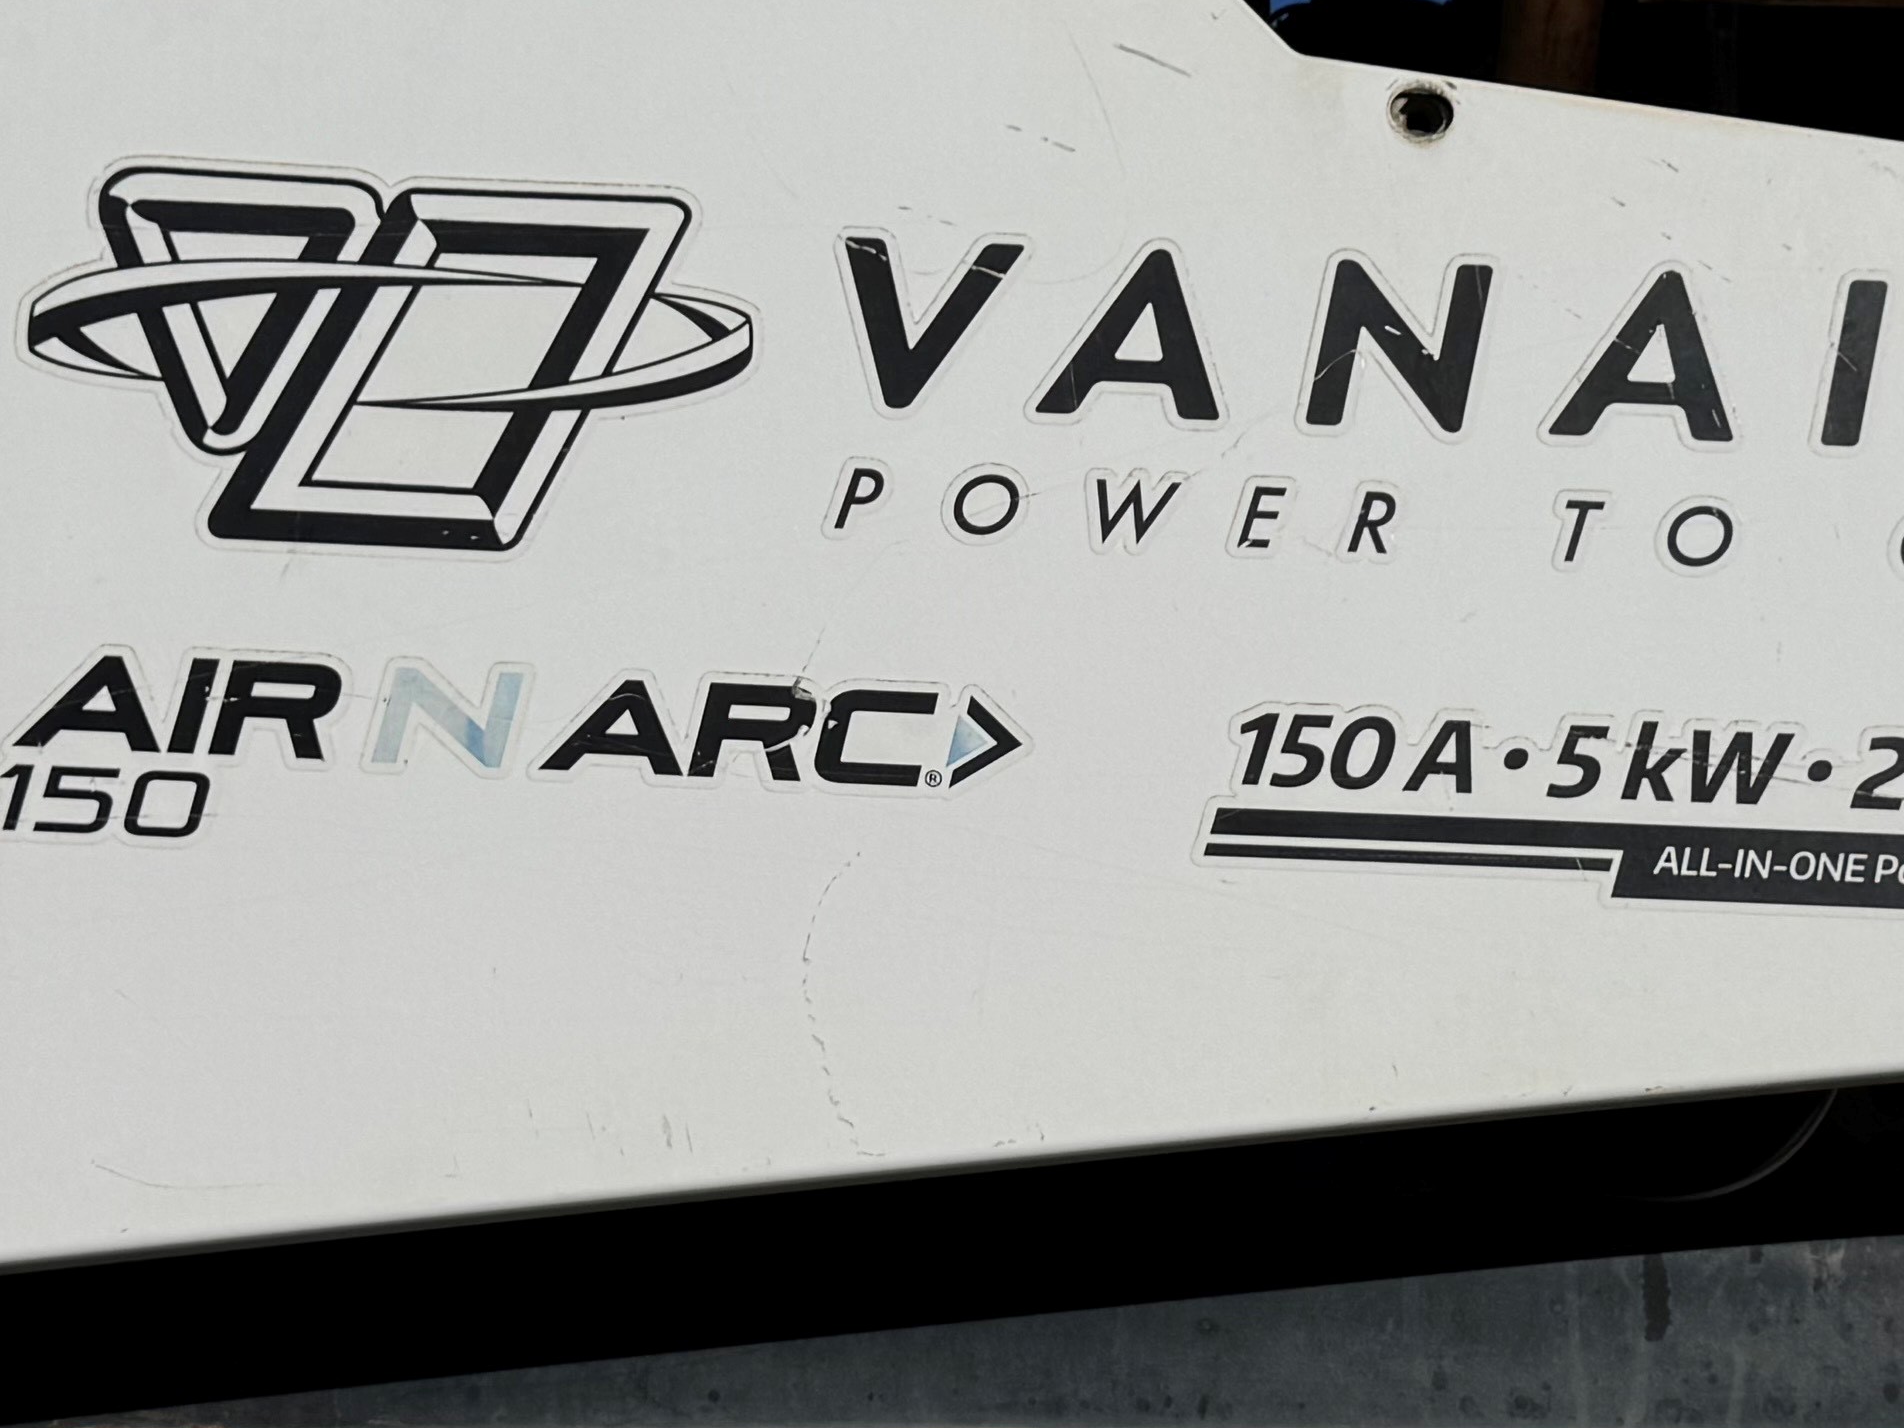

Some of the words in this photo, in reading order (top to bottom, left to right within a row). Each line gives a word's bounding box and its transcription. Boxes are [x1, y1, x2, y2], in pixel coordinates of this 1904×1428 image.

[833, 466, 1397, 555] POWER
[1563, 498, 1735, 568] TO
[11, 654, 343, 762] AIR
[370, 664, 527, 772] N
[1239, 711, 1397, 791] 150
[1652, 844, 1870, 884] ALL-IN-ONE
